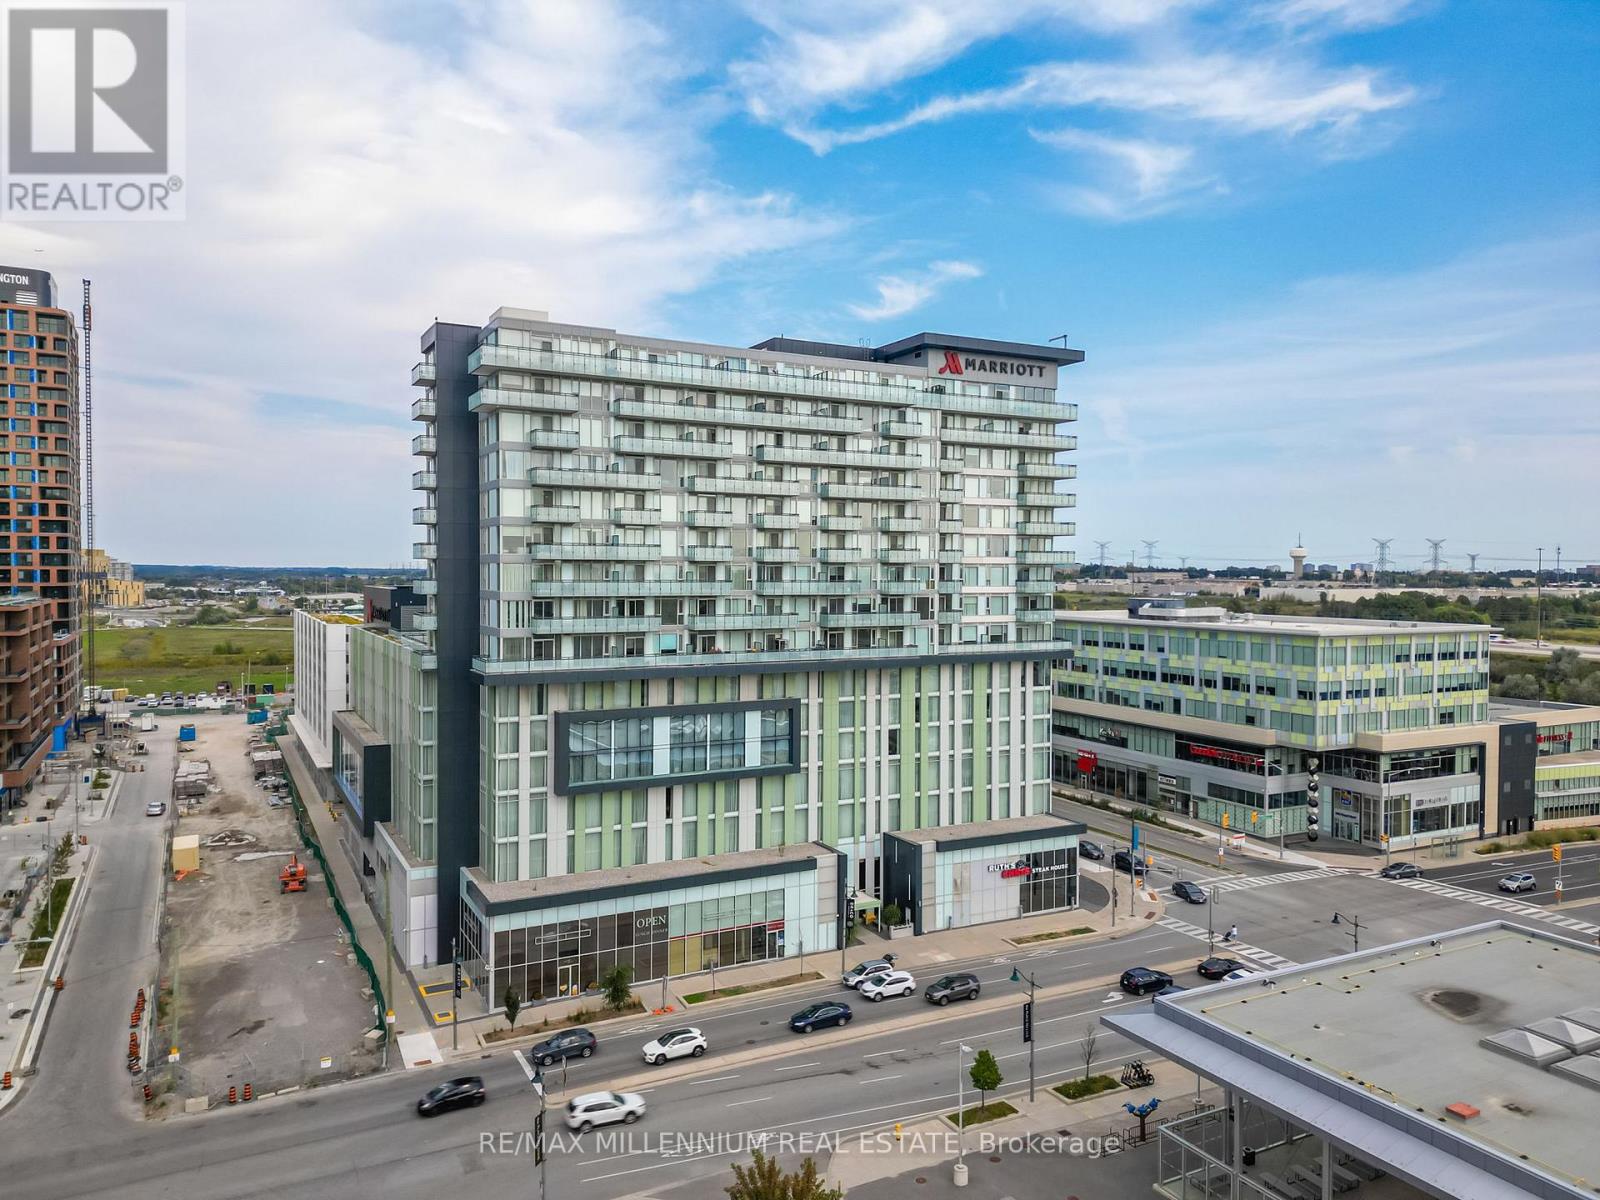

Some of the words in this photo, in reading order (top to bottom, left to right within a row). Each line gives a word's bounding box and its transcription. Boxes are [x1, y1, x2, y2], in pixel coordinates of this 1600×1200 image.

[964, 358, 1046, 378] MARRIOTT
[1032, 866, 1050, 874] STEAK
[1051, 863, 1069, 871] HOUSE
[636, 915, 666, 929] OPEN
